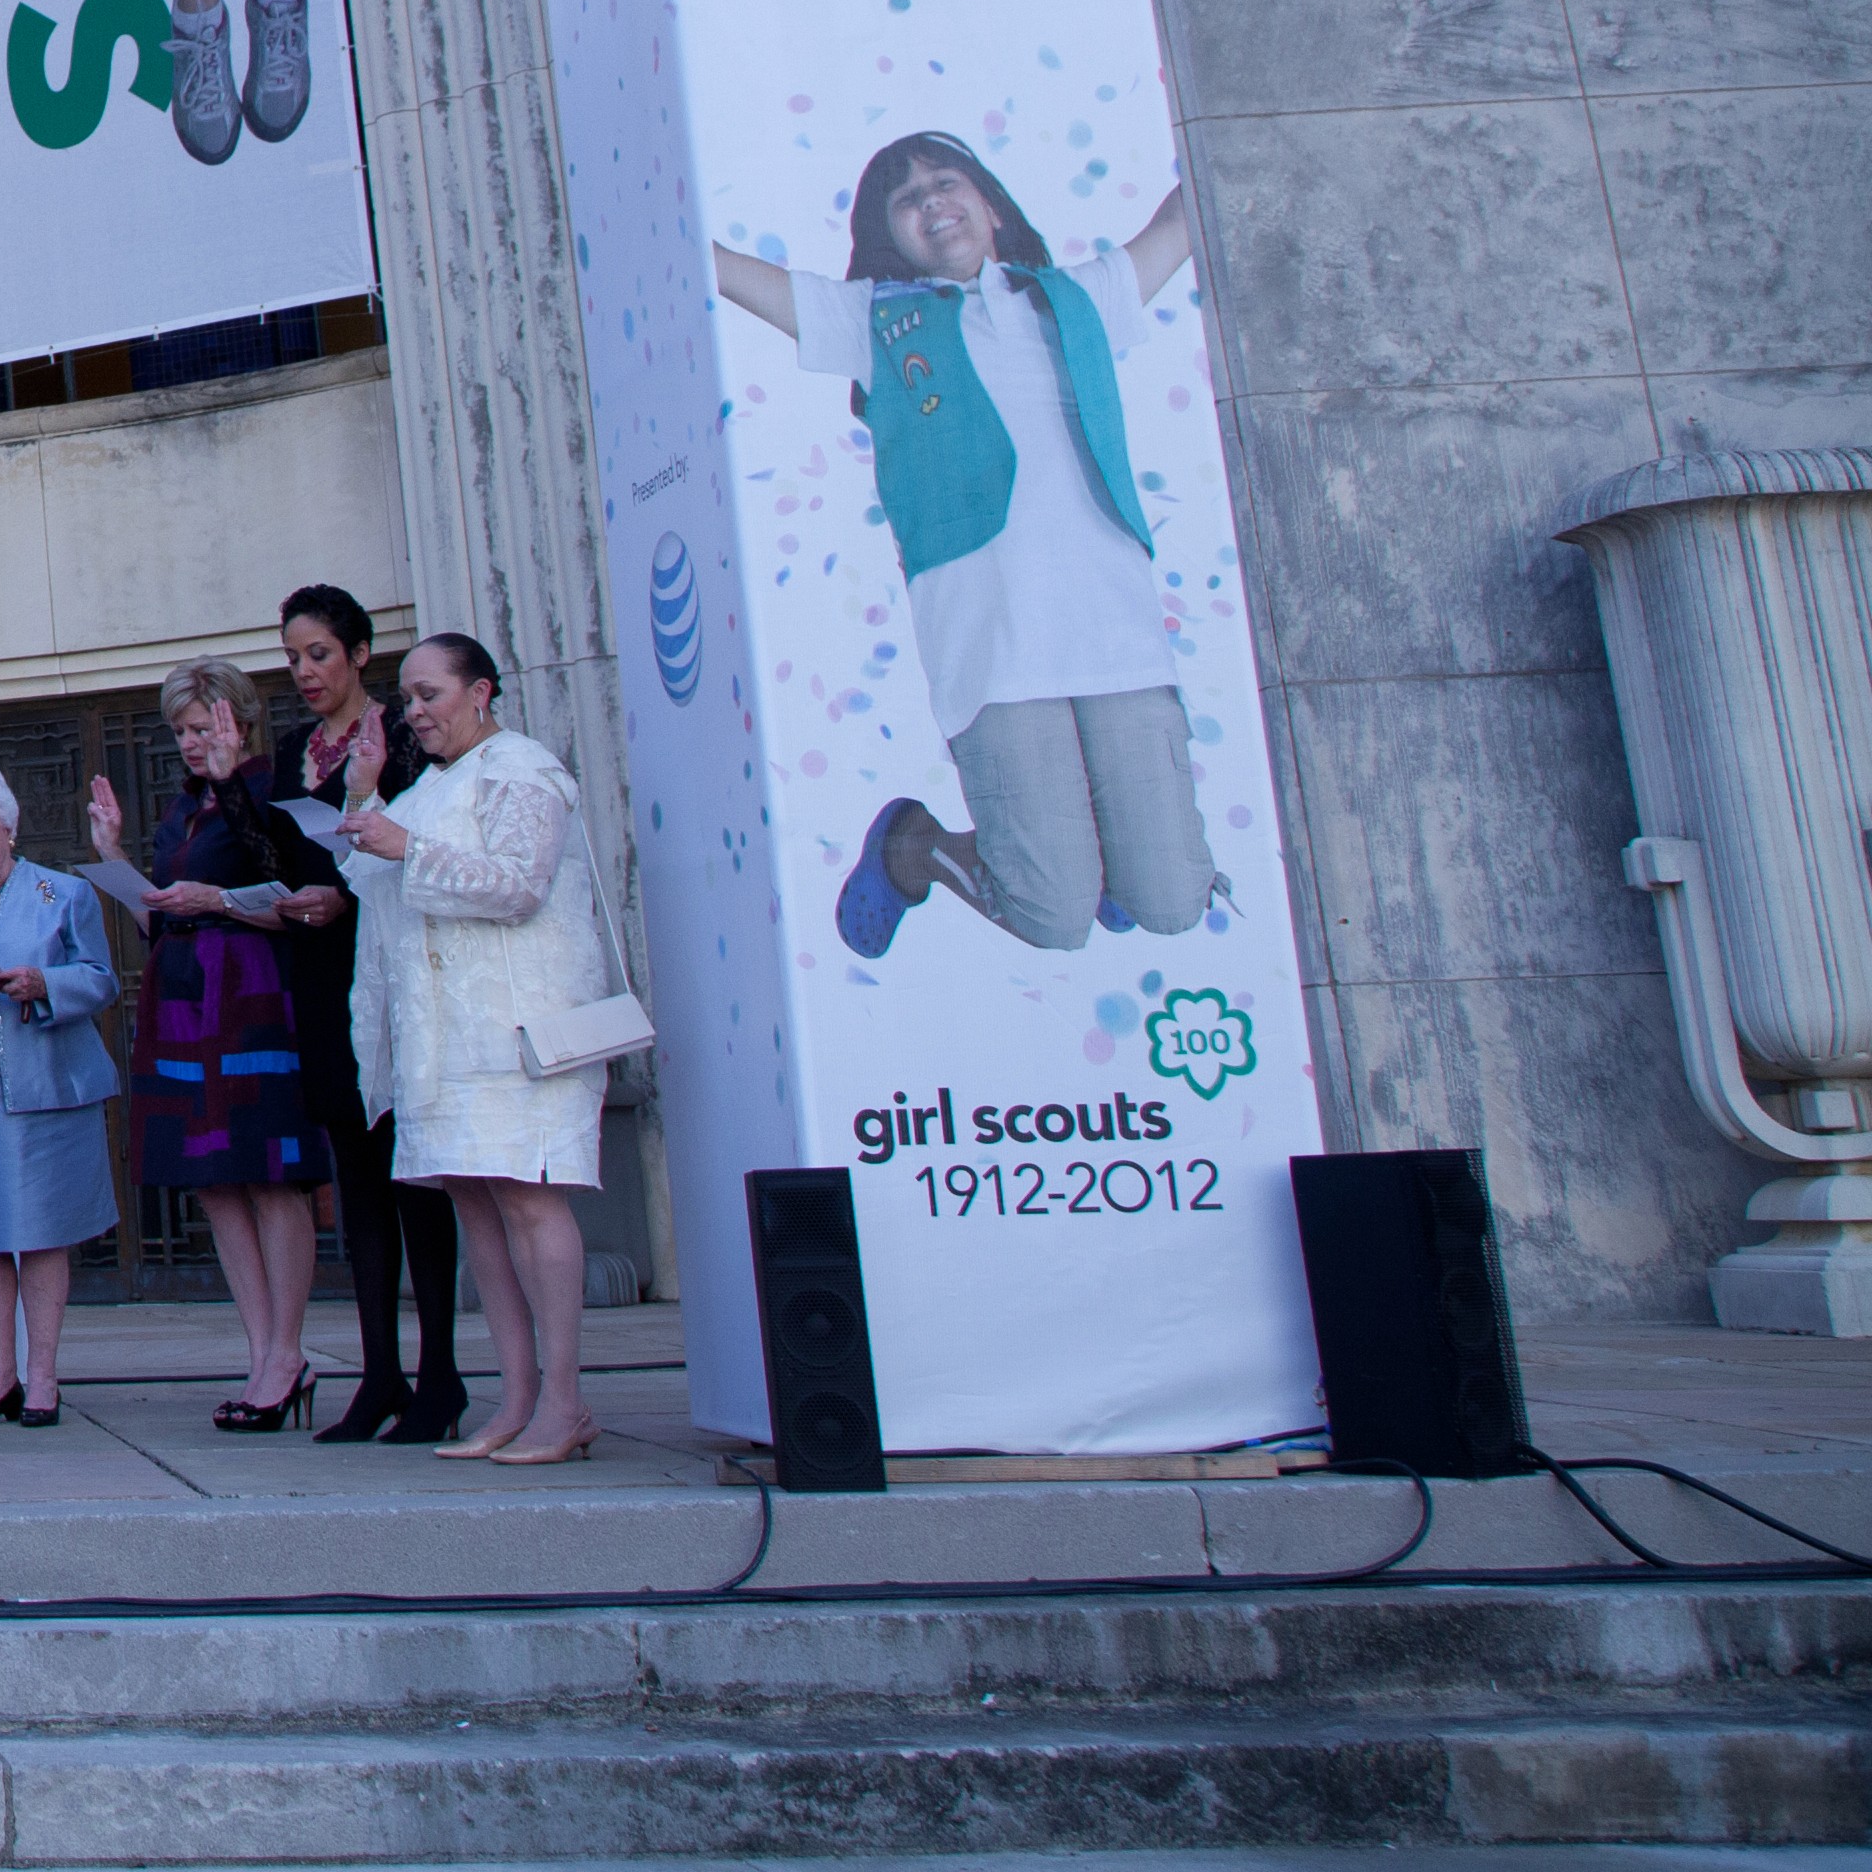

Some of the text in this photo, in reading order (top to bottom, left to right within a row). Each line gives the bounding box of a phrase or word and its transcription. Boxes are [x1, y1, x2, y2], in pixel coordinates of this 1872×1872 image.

[631, 454, 674, 507] Presented
[1170, 1029, 1229, 1056] 100
[853, 1087, 1172, 1164] girl scouts
[915, 1158, 1224, 1217] 1912-2012
